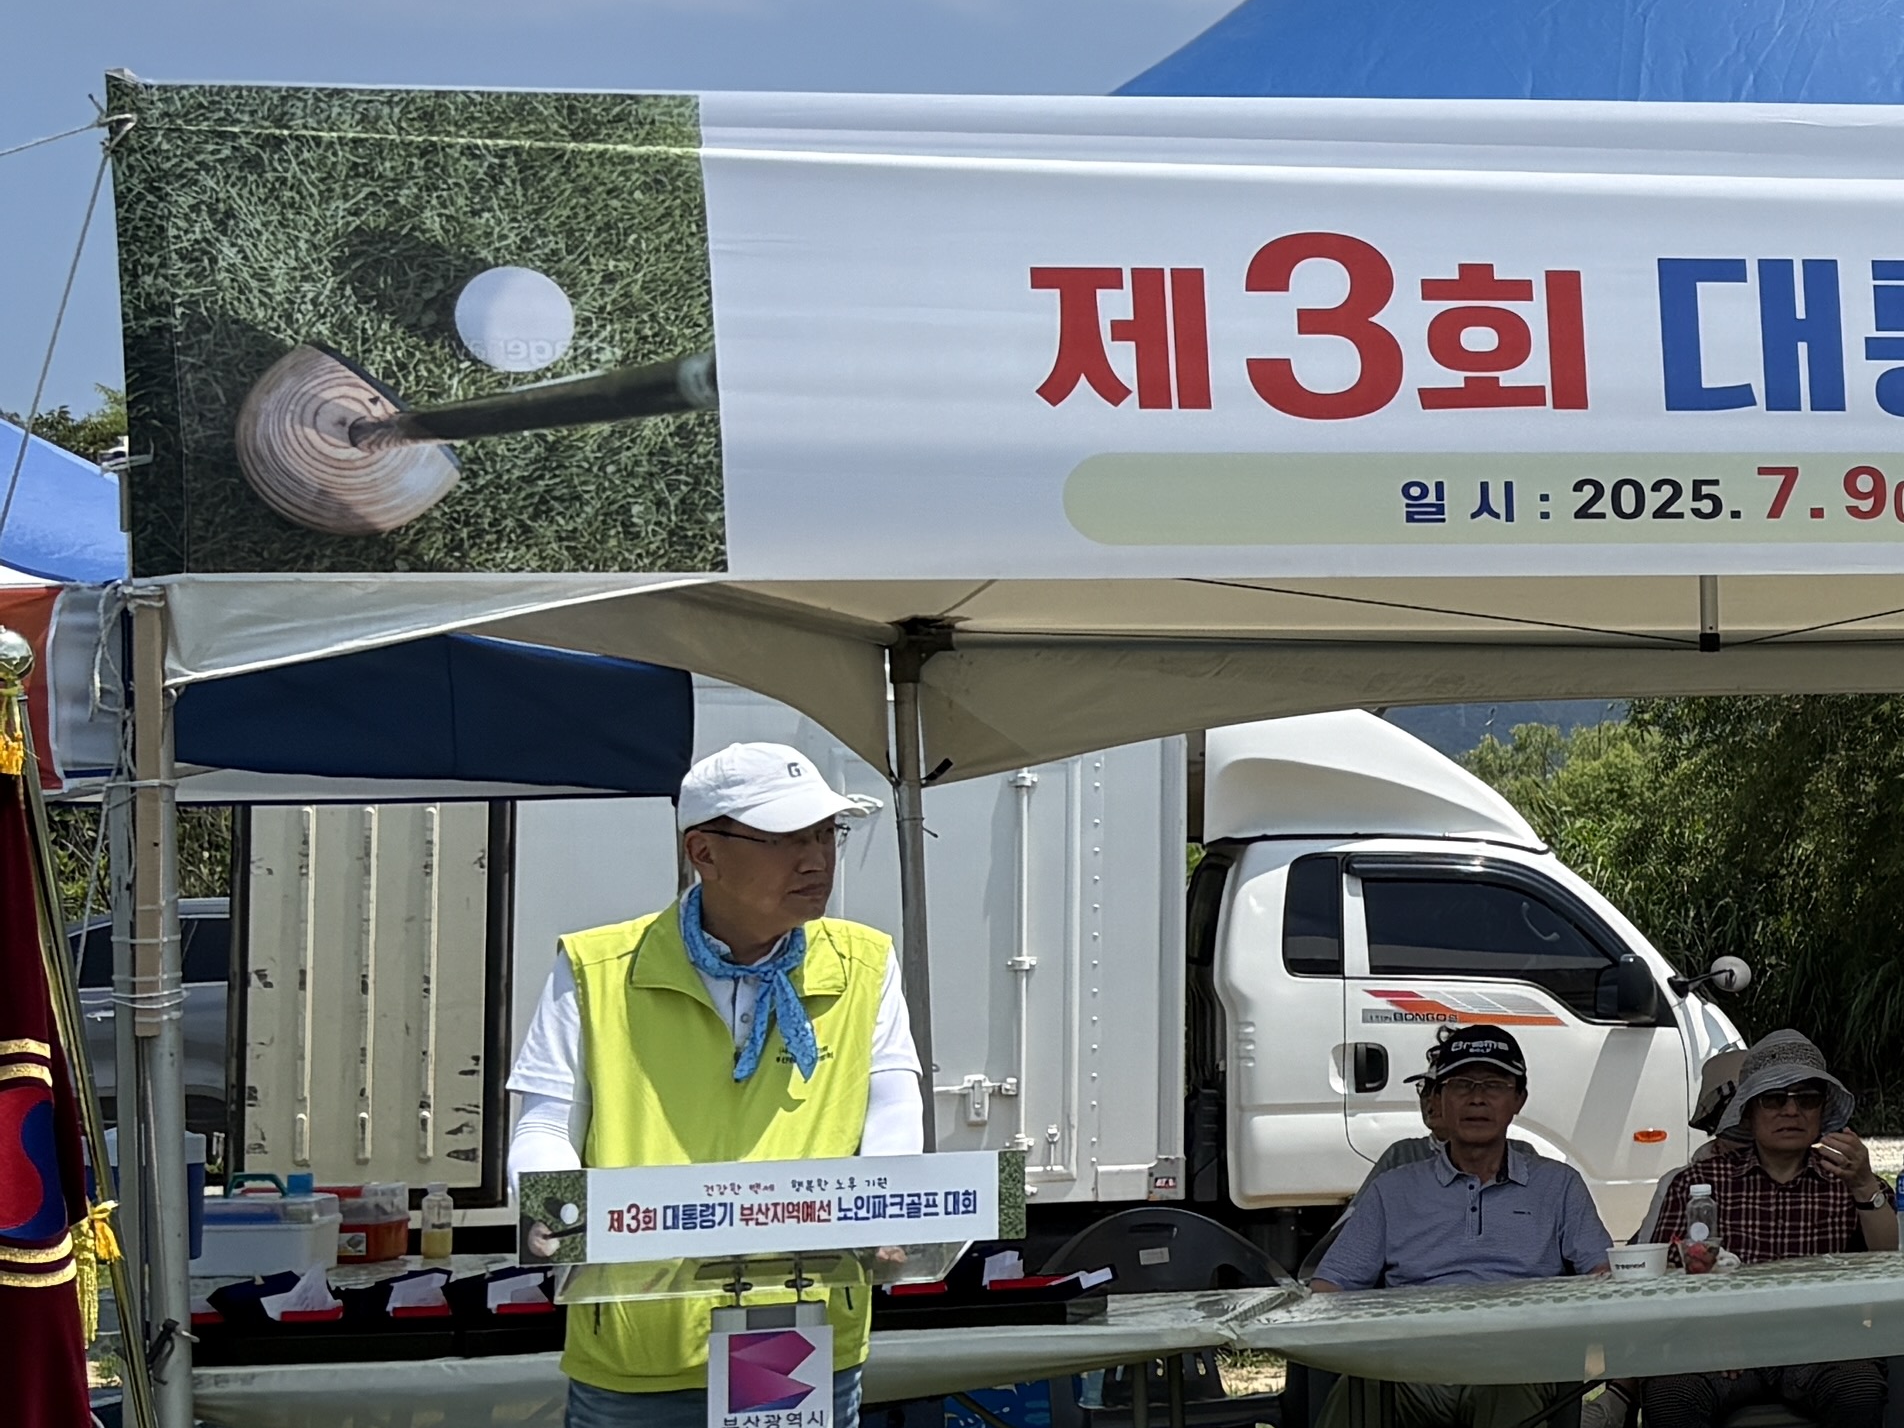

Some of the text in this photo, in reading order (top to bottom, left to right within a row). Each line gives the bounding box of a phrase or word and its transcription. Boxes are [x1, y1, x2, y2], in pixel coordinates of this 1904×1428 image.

[1028, 230, 1590, 422] 제3회
[607, 1189, 977, 1234] 제3회 대통령기 부산지역예선 노인파크골프 대회
